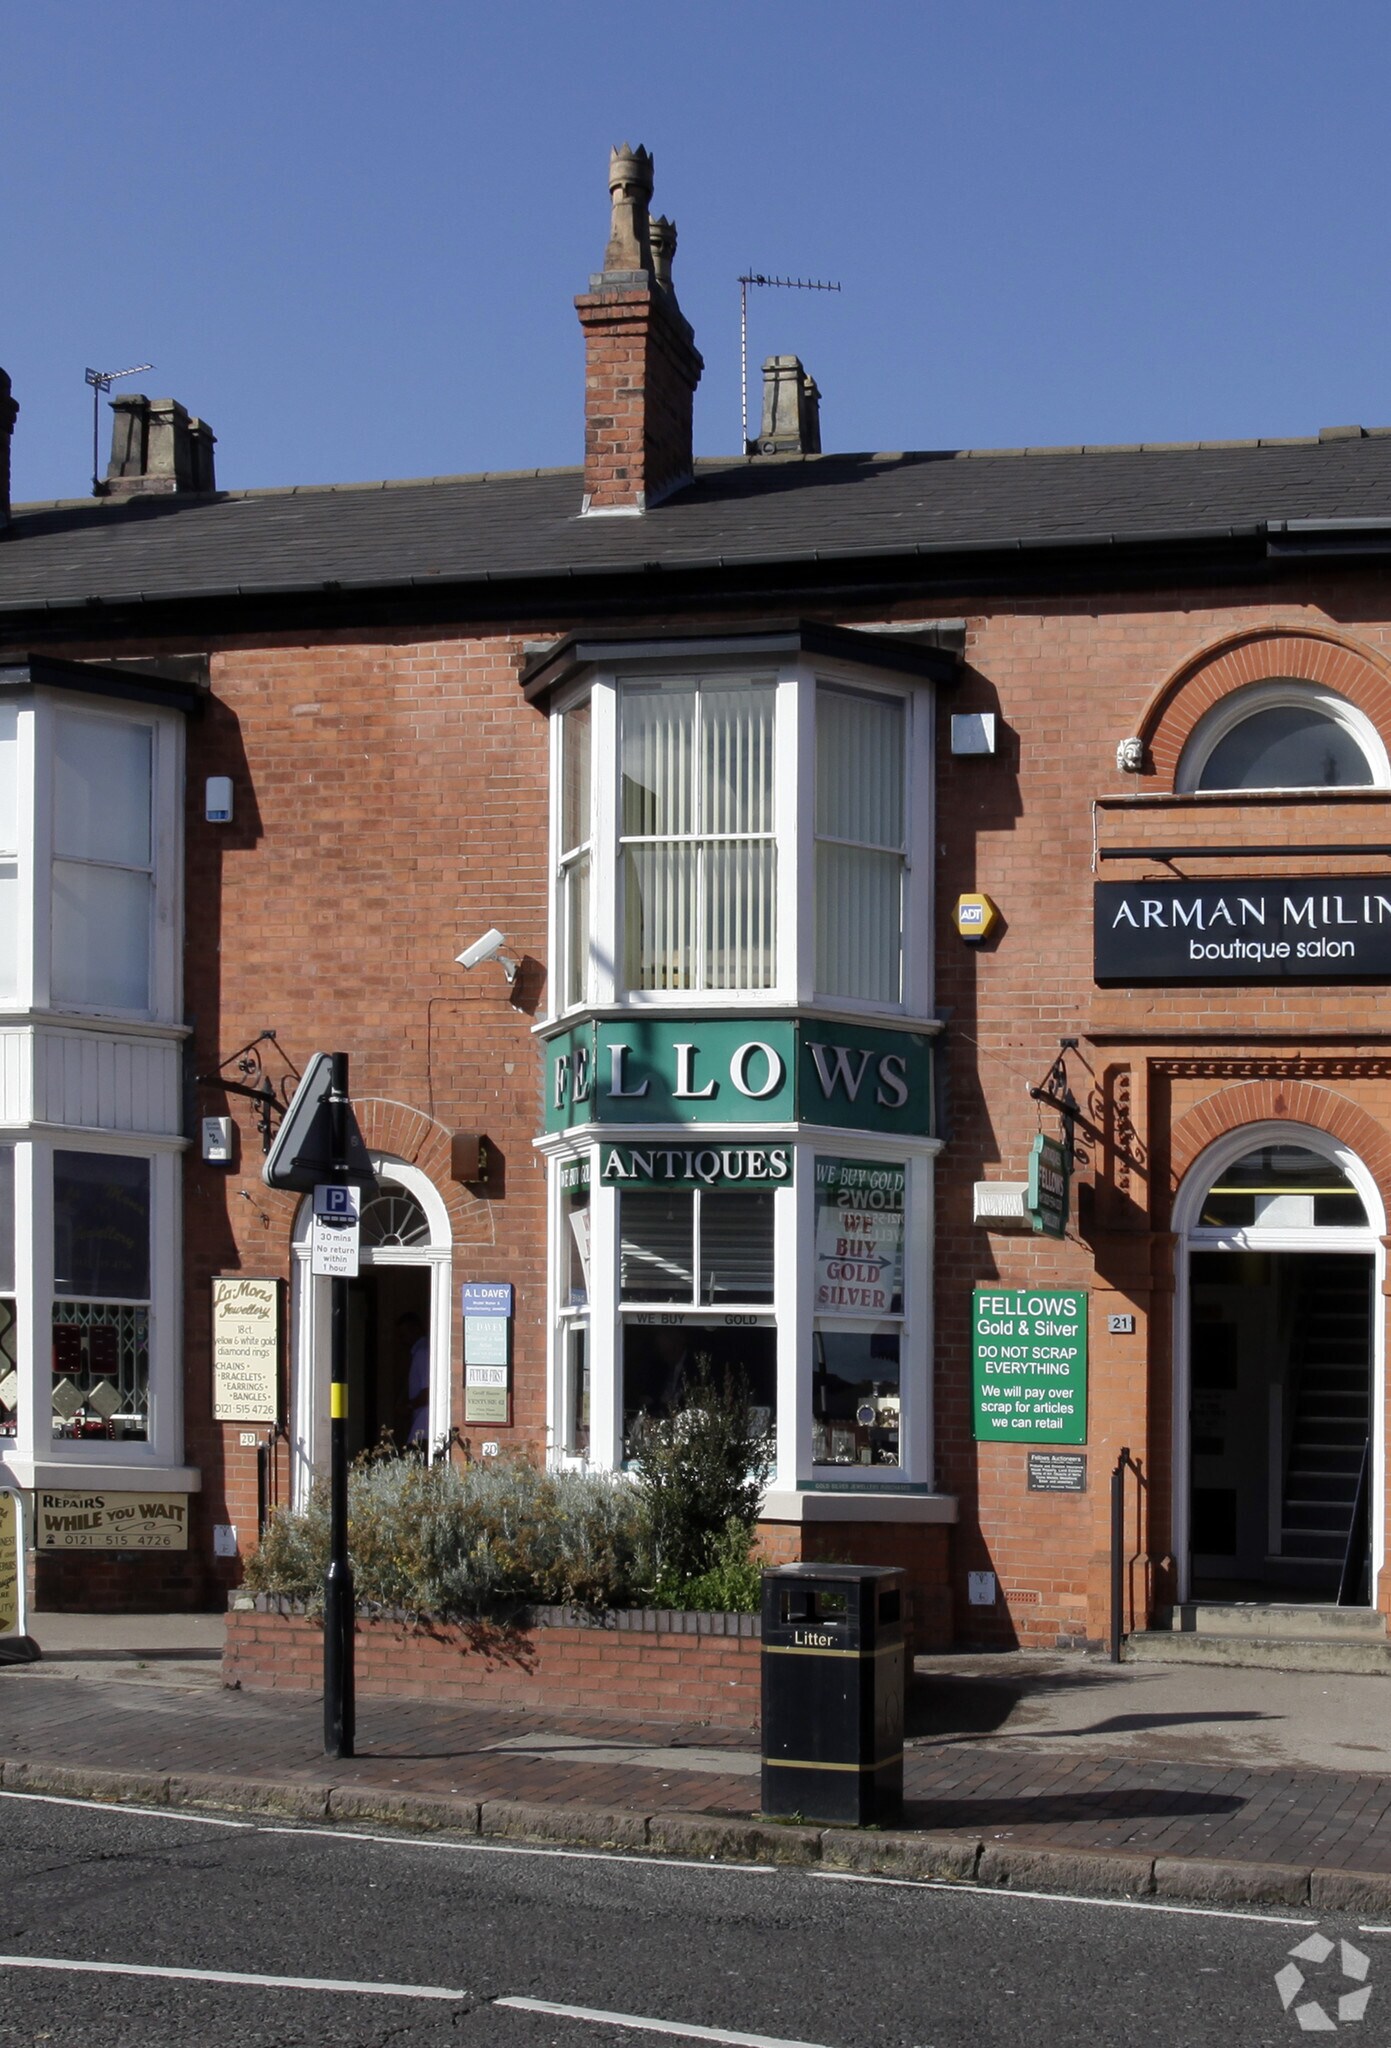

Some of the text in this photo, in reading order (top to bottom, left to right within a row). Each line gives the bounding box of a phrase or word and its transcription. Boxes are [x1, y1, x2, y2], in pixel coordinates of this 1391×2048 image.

[960, 908, 982, 921] ADT
[1112, 898, 1265, 930] ARMAN
[1190, 937, 1355, 962] boutique salon
[553, 1041, 909, 1109] FELLOWS
[602, 1149, 788, 1184] ANTIQUES
[816, 1164, 904, 1192] WE BUY GOLD
[331, 1191, 344, 1210] P
[844, 1215, 873, 1235] WE
[320, 1233, 352, 1242] 30 mins
[316, 1245, 355, 1254] No return
[836, 1238, 877, 1259] BUY
[323, 1255, 348, 1263] within
[329, 1264, 347, 1272] hour
[827, 1262, 880, 1283] GOLD
[481, 1289, 510, 1298] DAVEY
[819, 1285, 885, 1308] SILVER
[219, 1304, 271, 1320] Jewellery
[979, 1297, 1077, 1316] FELLOWS
[637, 1314, 757, 1325] WE BUY GOLD
[1113, 1317, 1128, 1329] 21
[977, 1320, 1078, 1336] Gold & Silver
[240, 1336, 260, 1346] white
[261, 1336, 276, 1347] gold
[217, 1348, 270, 1358] diamond rings
[978, 1346, 1077, 1359] DO NOT SCRAP
[985, 1362, 1070, 1375] EVERYTHING
[981, 1385, 1074, 1400] We will pay over
[252, 1405, 274, 1414] 4726
[981, 1401, 1074, 1414] scrap for articles
[991, 1418, 1063, 1429] we can retail
[241, 1434, 254, 1444] 20
[484, 1443, 497, 1455] 20
[43, 1494, 105, 1509] REPAIRS
[44, 1504, 186, 1532] WHILE YOU WAIT
[65, 1535, 171, 1545] 0121 515 4726
[795, 1631, 834, 1646] Litter
